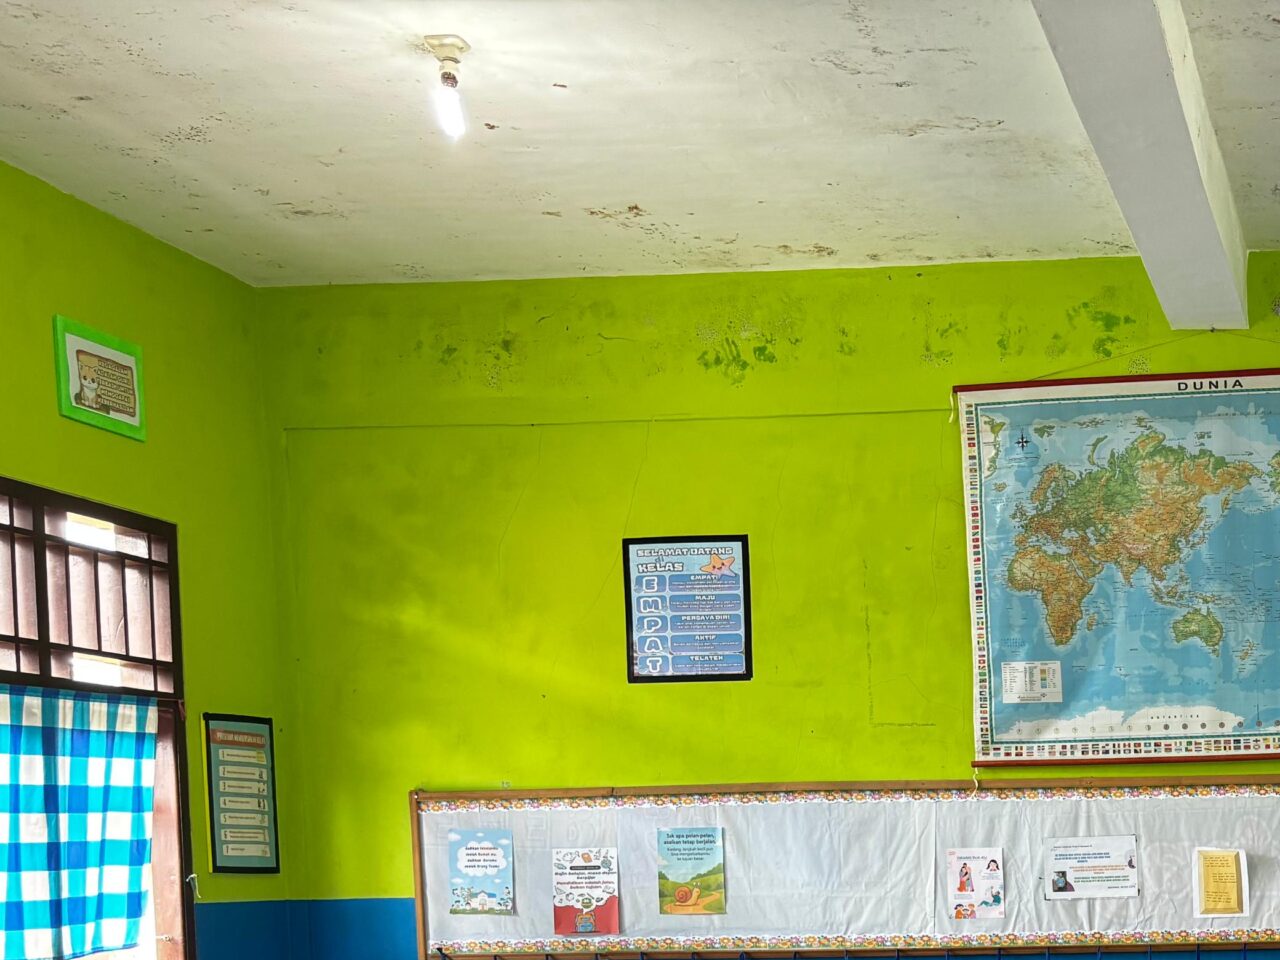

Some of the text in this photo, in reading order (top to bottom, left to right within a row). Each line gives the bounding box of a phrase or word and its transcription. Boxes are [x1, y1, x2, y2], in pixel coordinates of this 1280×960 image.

[1177, 379, 1244, 391] DUNIA
[636, 546, 734, 558] SELAMAT DATANG
[637, 562, 685, 574] KELAS
